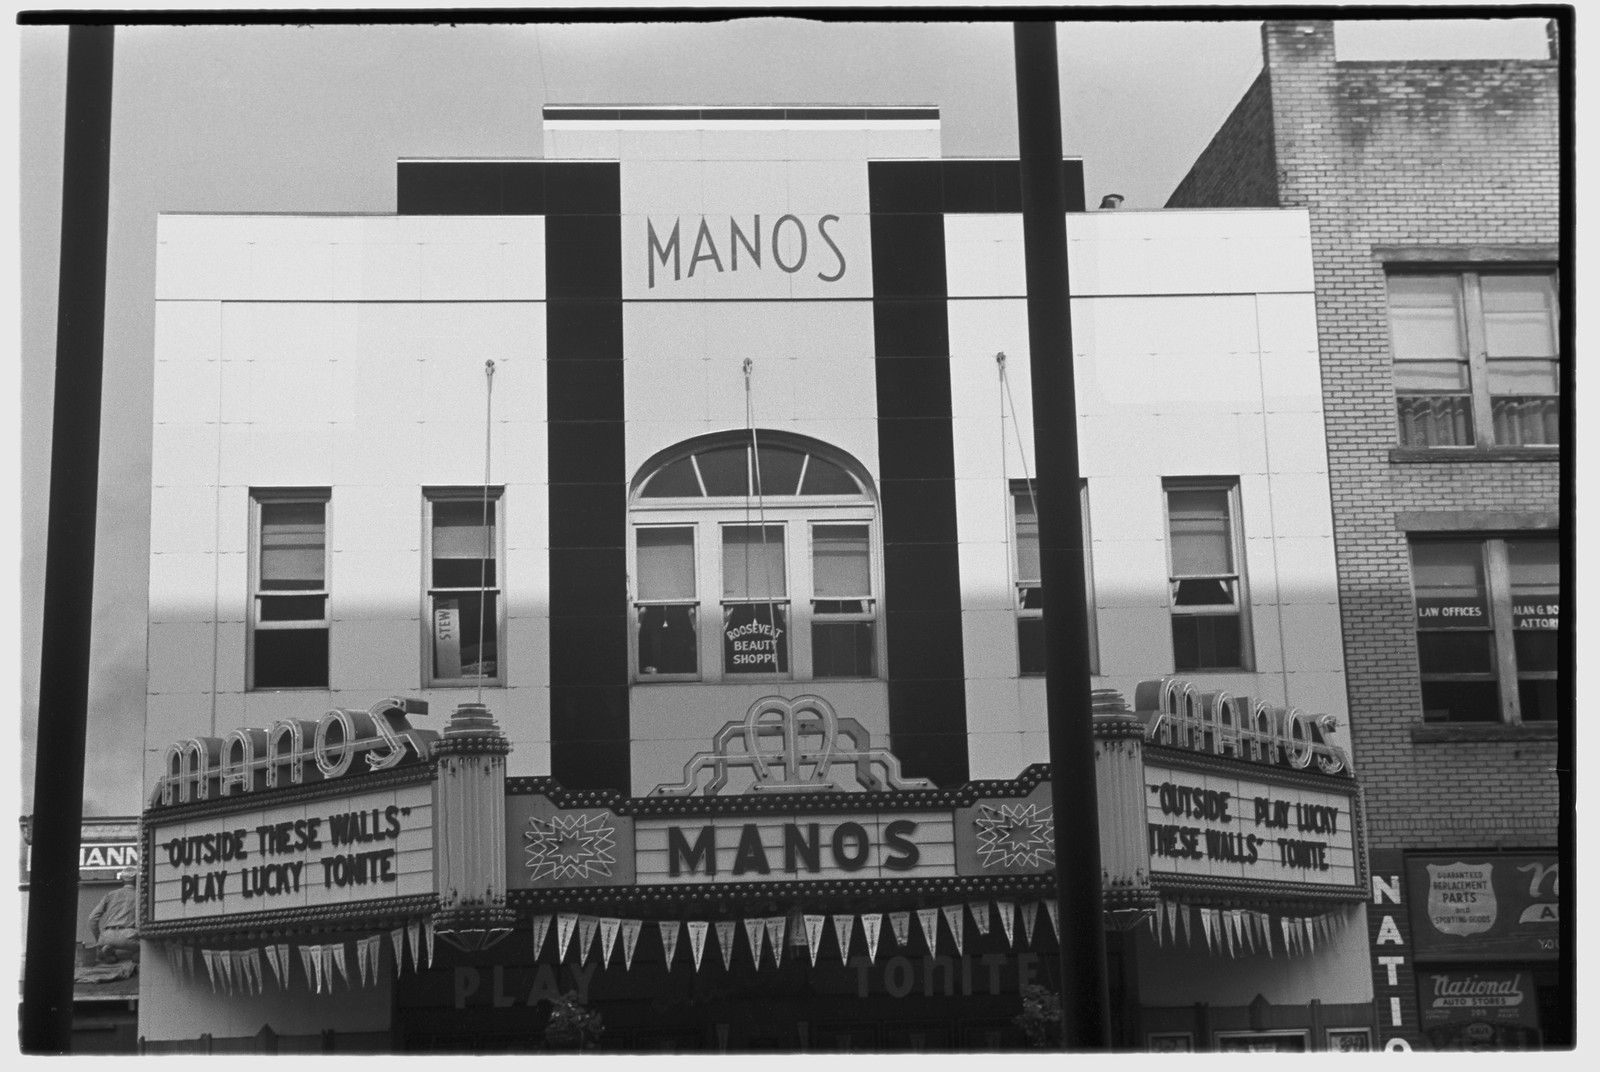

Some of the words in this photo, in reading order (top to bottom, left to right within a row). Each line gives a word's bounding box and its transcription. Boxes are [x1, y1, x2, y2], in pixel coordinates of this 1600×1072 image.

[647, 214, 846, 289] MANOS
[1419, 607, 1439, 617] LAW
[1442, 606, 1482, 617] OFFICES
[1513, 605, 1535, 615] ALAN
[726, 623, 783, 641] ROOSEVELT
[734, 640, 778, 652] BEAUTY
[733, 653, 777, 664] SHOPPE
[1254, 797, 1290, 829] PLAY
[1296, 802, 1338, 835] LUCKY
[257, 818, 322, 856] THESE
[667, 819, 920, 878] MANOS
[1149, 823, 1203, 860] THESE
[1277, 837, 1329, 871] TONITE
[181, 870, 227, 904] PLAY
[242, 861, 304, 898] LUCKY
[321, 848, 396, 889] TONITE
[1433, 880, 1487, 890] REPLACEMENT
[1442, 892, 1477, 903] PARTS
[455, 961, 598, 1010] PLAY
[848, 952, 1040, 998] TONITE
[1430, 973, 1523, 996] National
[1443, 998, 1467, 1006] AUTO
[1471, 998, 1507, 1006] STORES
